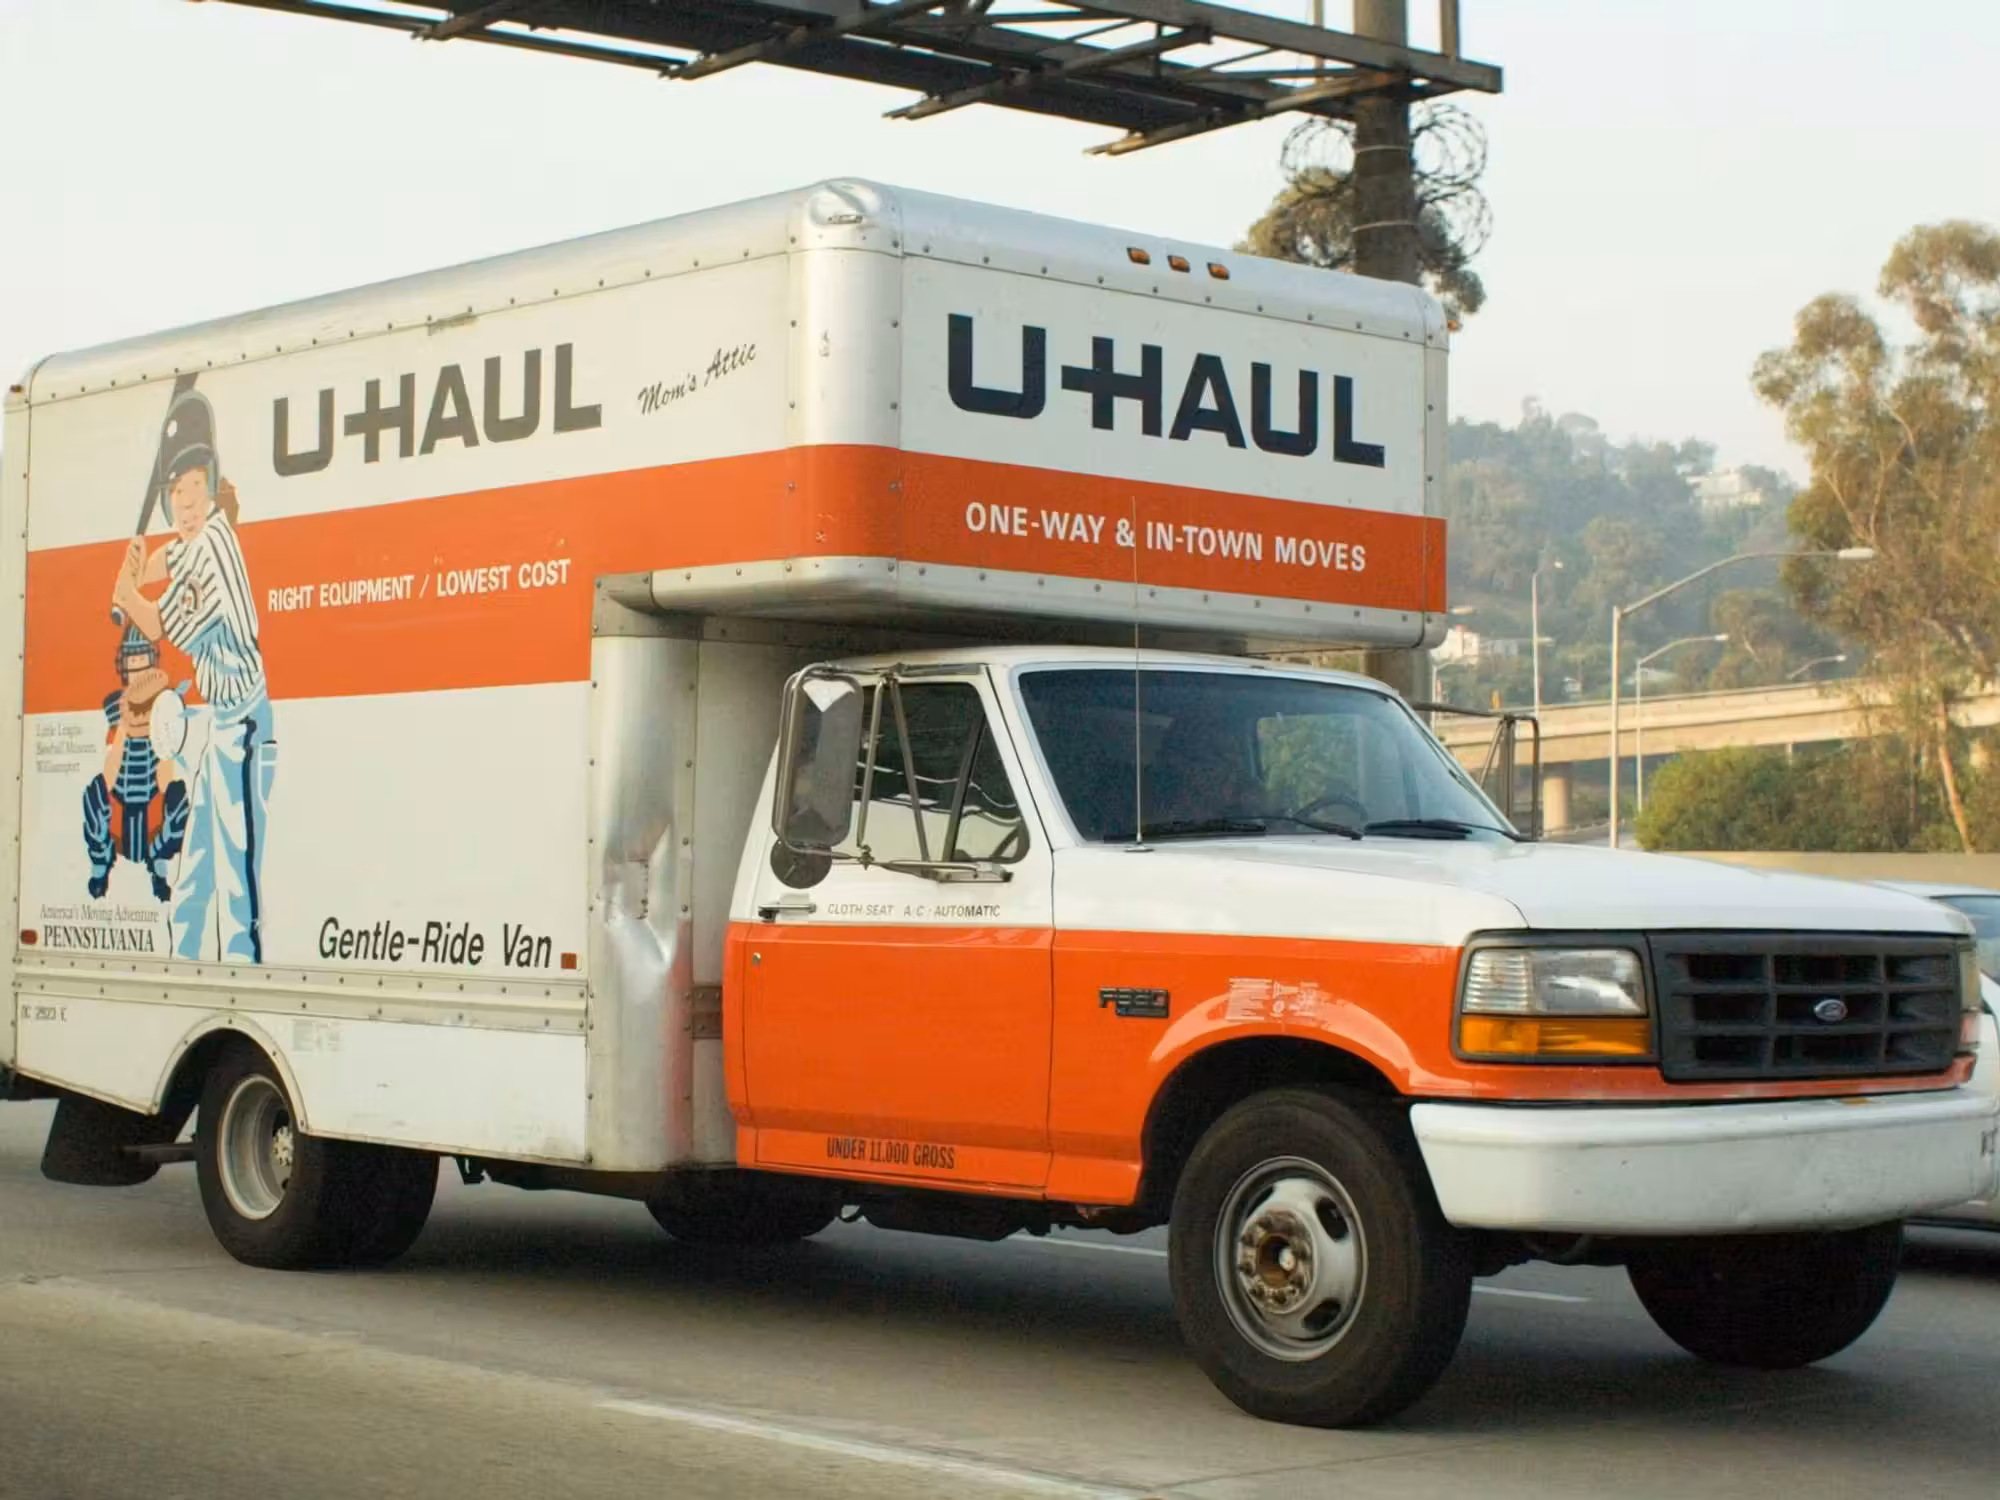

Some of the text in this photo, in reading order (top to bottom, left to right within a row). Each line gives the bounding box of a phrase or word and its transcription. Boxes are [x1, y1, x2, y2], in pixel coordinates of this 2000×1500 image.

[637, 343, 757, 415] Mom's Attic
[965, 502, 1366, 572] ONE-WAY & IN-TOWN MOVES
[268, 585, 315, 612] RIGHT
[319, 574, 415, 608] EQUIPMENT
[437, 565, 512, 598] LOWEST
[518, 558, 571, 588] COST
[865, 904, 895, 917] SEAT
[935, 904, 1001, 918] AUTOMATIC
[43, 924, 155, 953] PENNSYLVANIA
[319, 916, 552, 969] Gentle-Ride Van
[826, 1137, 866, 1161] UNDER
[913, 1143, 956, 1170] GROSS
